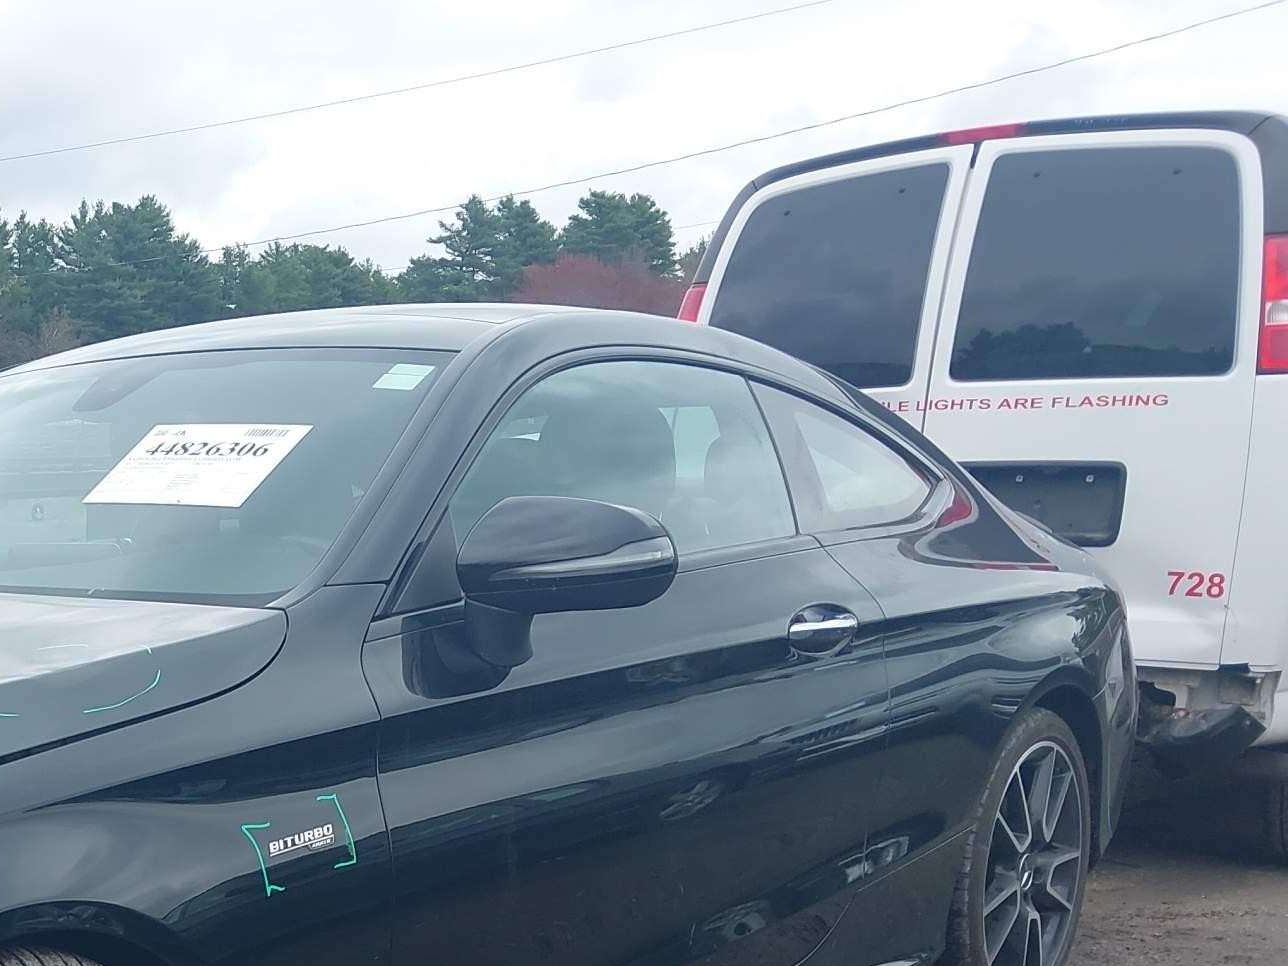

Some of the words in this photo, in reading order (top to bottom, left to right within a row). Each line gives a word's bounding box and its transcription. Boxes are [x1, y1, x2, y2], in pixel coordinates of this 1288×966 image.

[916, 398, 991, 411] LIGHTS
[997, 397, 1044, 410] ARE
[1051, 394, 1170, 408] FLASHING
[145, 441, 273, 456] 44826306
[1168, 571, 1225, 598] 728
[269, 823, 333, 854] BITURBO
